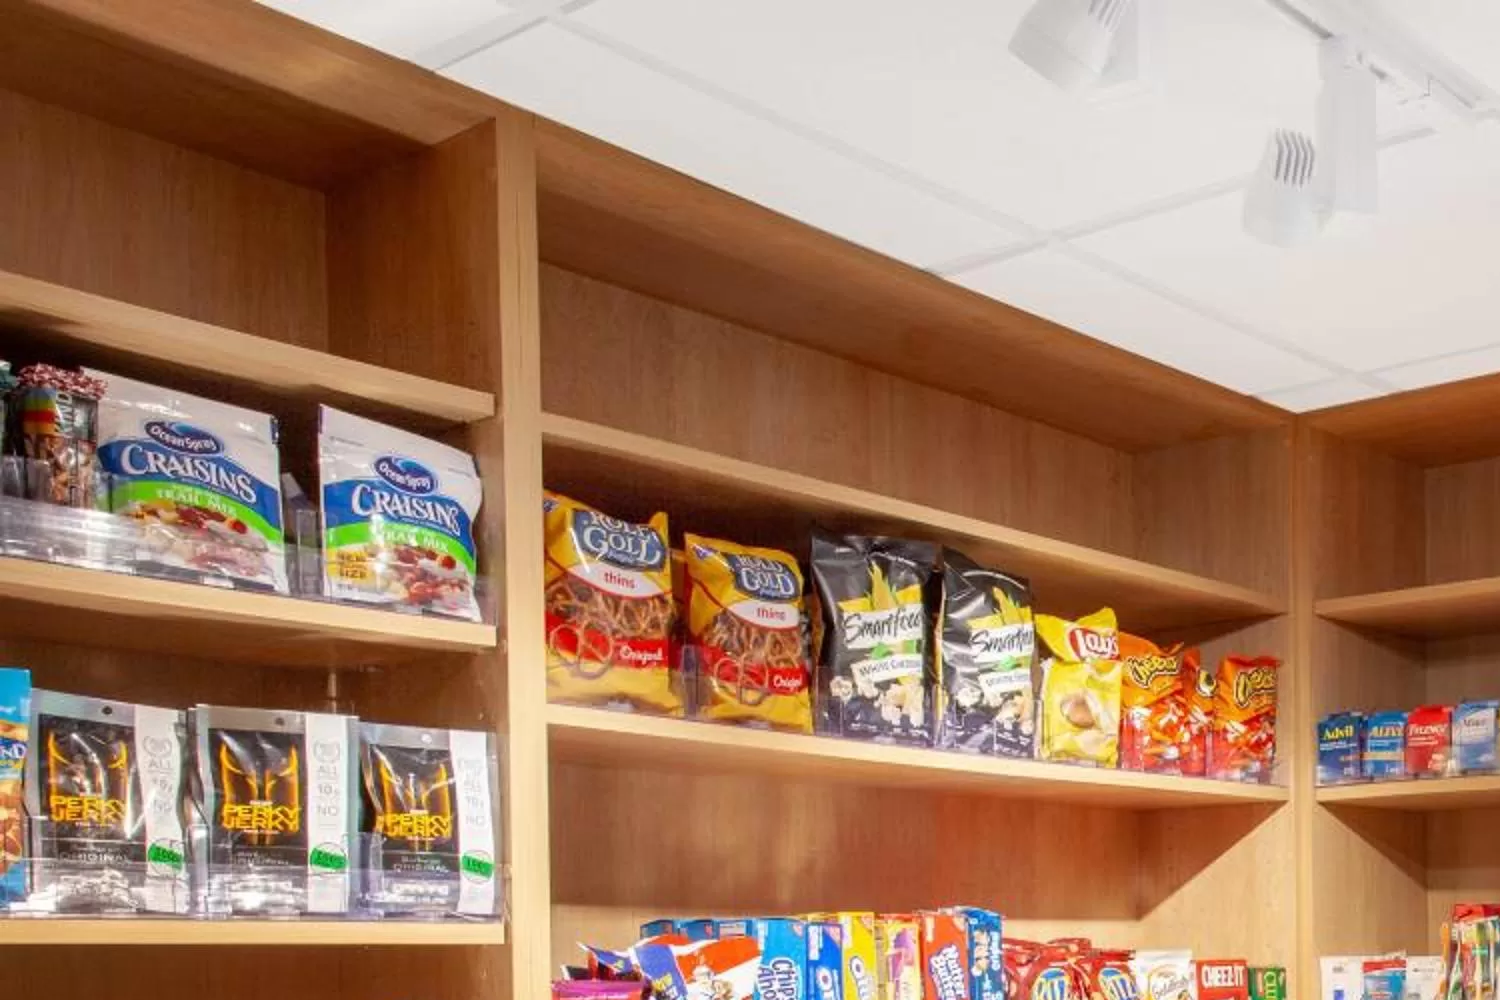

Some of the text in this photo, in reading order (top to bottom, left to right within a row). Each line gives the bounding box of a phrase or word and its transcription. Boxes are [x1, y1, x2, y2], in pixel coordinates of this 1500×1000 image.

[120, 444, 257, 503] CRAISINS
[352, 484, 461, 537] CRAISINS
[584, 527, 661, 565] GOLD
[603, 571, 636, 589] thins
[741, 567, 794, 596] GOLD
[1323, 726, 1354, 741] Advil
[51, 796, 126, 811] PERKY
[223, 804, 301, 818] PERKY
[51, 808, 126, 825] JERKY
[222, 816, 300, 832] JERKY
